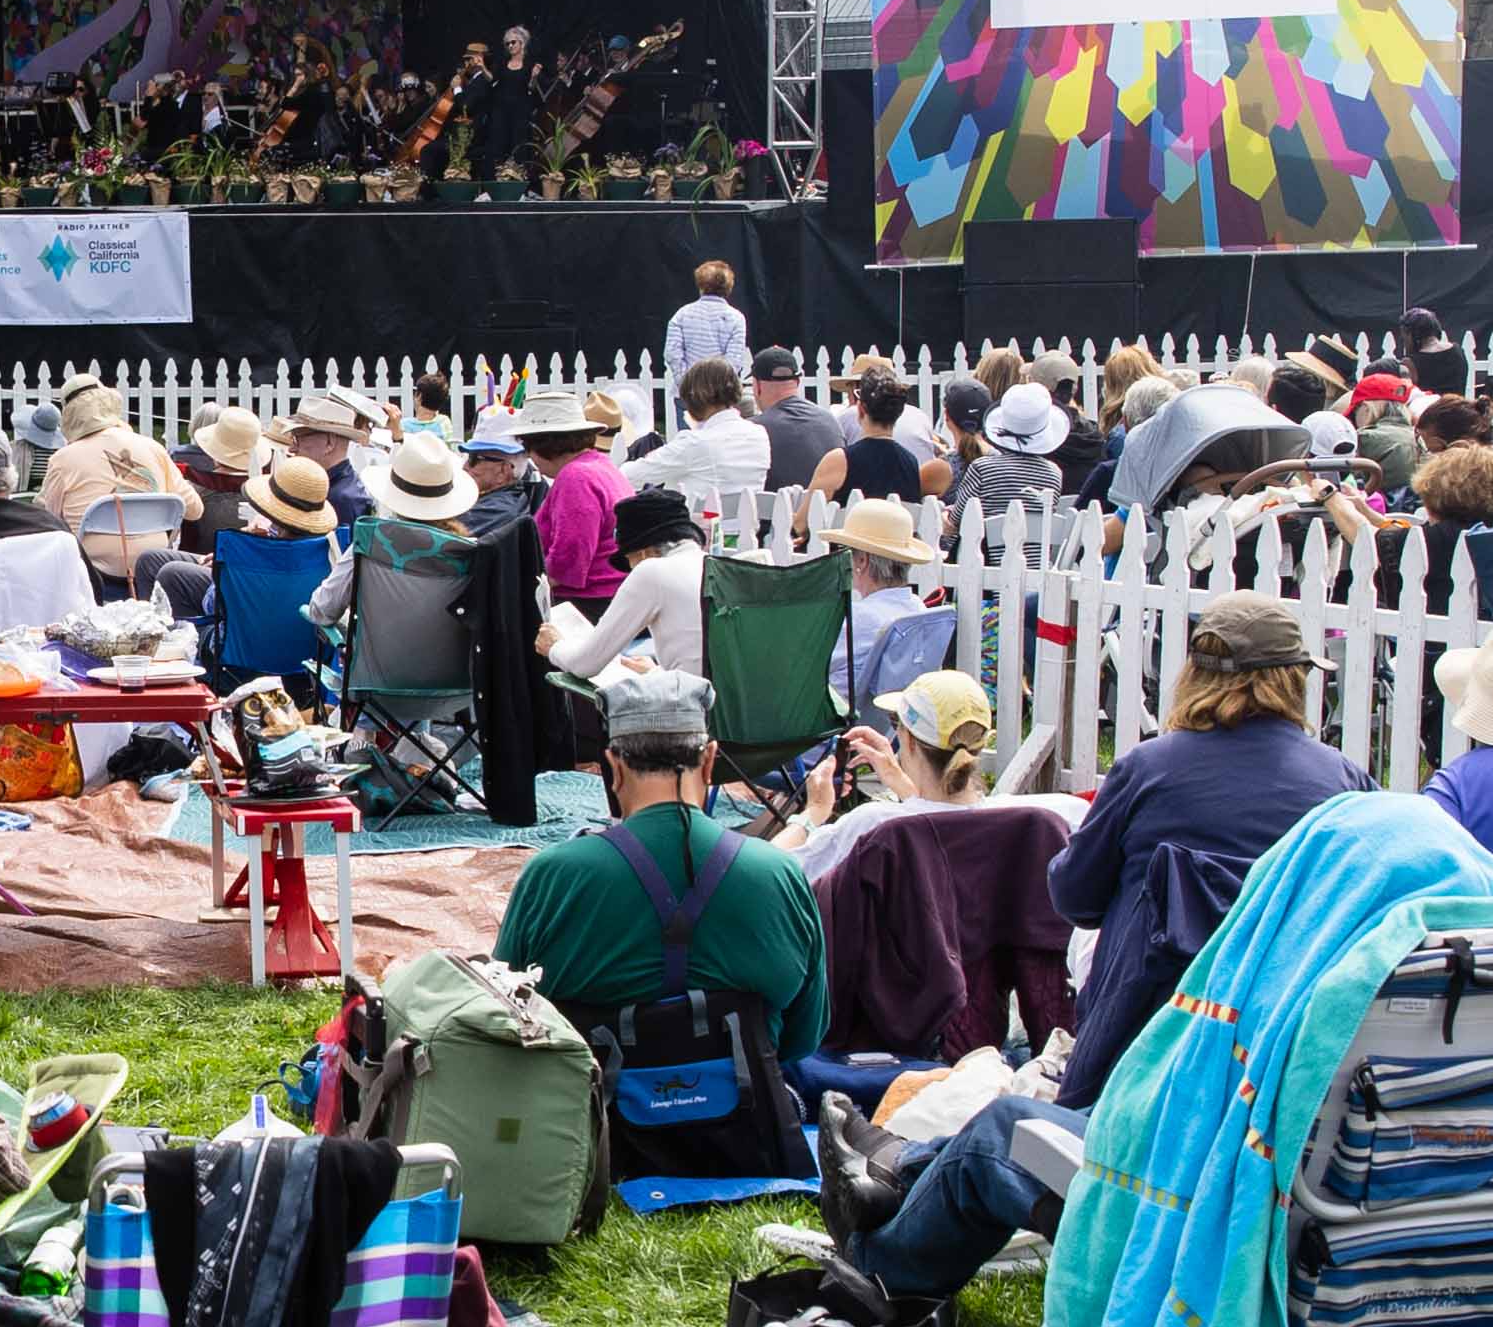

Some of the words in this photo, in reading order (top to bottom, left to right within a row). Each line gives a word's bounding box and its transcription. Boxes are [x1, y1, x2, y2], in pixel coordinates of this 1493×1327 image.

[88, 223, 130, 231] PARTNER
[88, 239, 137, 251] Classical
[88, 250, 140, 261] California
[89, 261, 132, 273] KDFC
